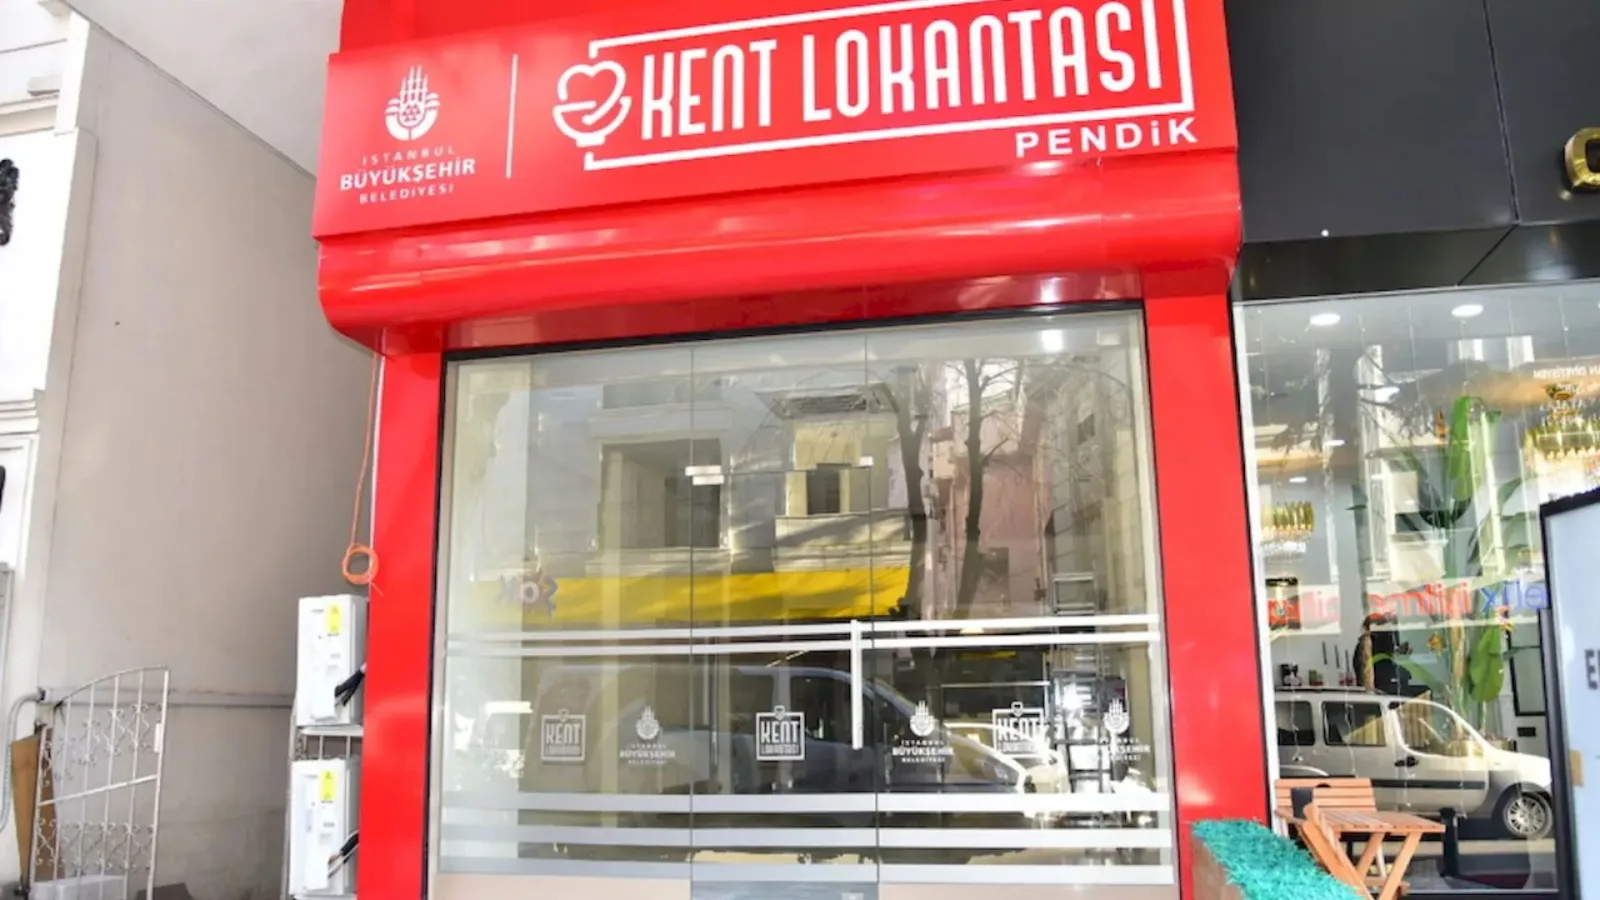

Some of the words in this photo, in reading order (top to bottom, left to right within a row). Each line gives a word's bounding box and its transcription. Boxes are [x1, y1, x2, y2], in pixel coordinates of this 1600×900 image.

[641, 39, 777, 140] KENT
[803, 0, 1161, 122] LOKANTASI
[340, 156, 476, 191] BÜYÜKŞEHİR
[545, 723, 581, 744] KENT
[760, 720, 800, 743] KENT
